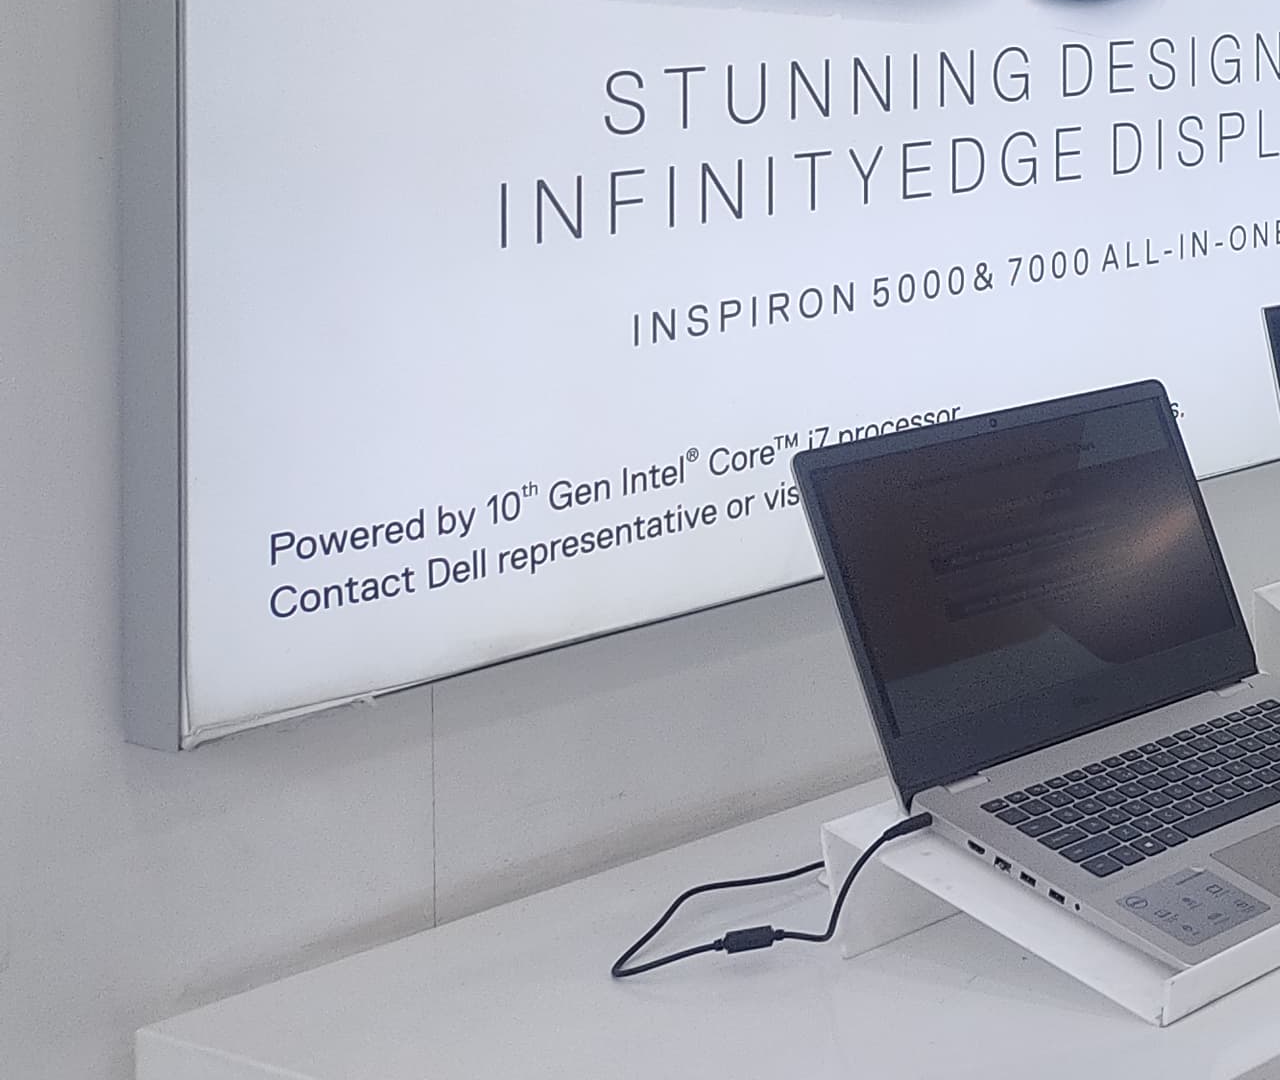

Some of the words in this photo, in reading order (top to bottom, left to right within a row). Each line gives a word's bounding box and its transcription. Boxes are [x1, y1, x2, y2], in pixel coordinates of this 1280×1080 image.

[603, 46, 1031, 136] STUNNING
[500, 126, 1082, 249] INFINITYEDGE
[633, 281, 855, 347] INSPIRON
[1008, 247, 1089, 287] 7000
[269, 509, 426, 566] Powered
[437, 506, 477, 538] by
[486, 481, 539, 524] 10th
[549, 478, 612, 511] Gen
[269, 566, 416, 619] Contact
[428, 548, 488, 589] Dell
[498, 500, 718, 576] representative
[726, 493, 756, 519] or
[764, 481, 800, 511] vis
